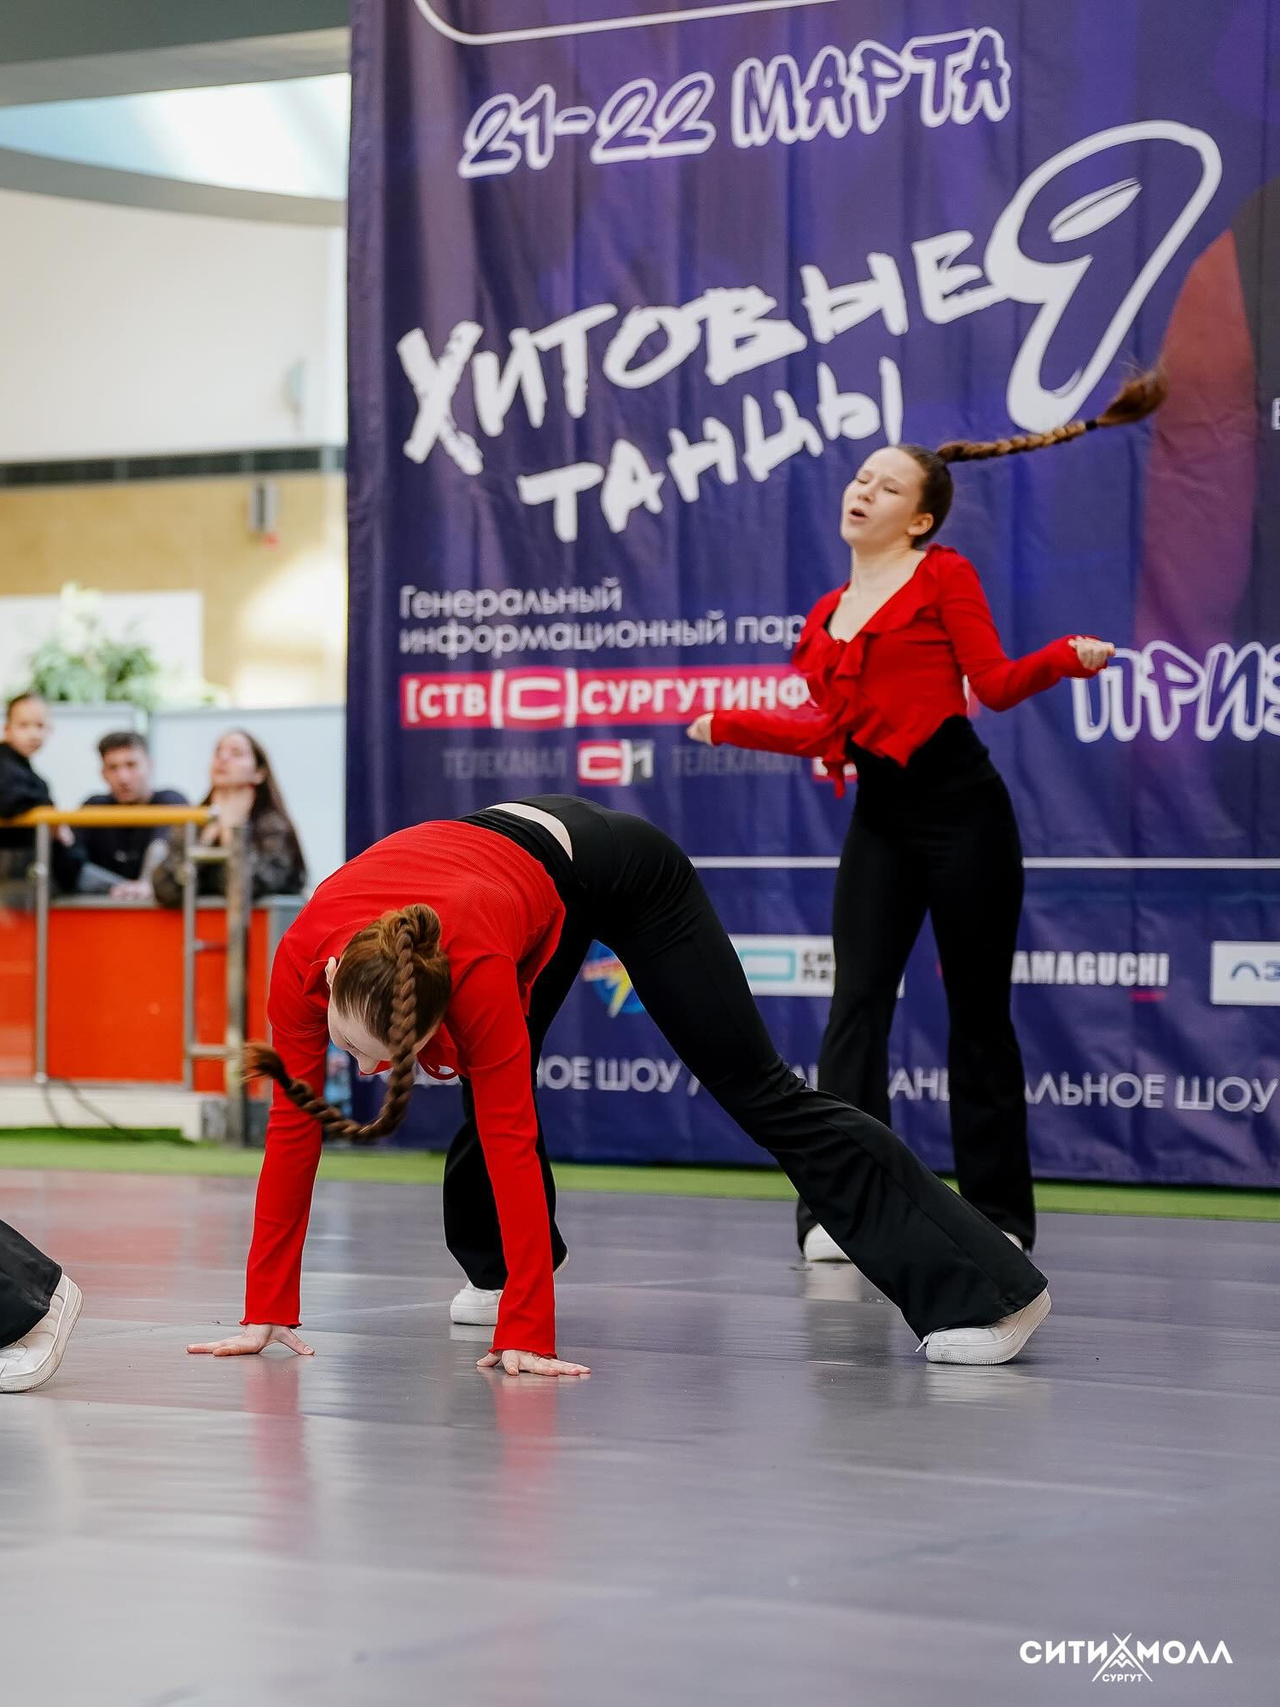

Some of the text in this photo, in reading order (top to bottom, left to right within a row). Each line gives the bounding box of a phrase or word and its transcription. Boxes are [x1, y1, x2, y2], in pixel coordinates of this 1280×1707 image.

[459, 27, 1011, 179] 21-22 МАРТА
[397, 229, 1005, 476] ХИТОВЫЕ
[517, 356, 902, 543] ТАНЦЫ
[399, 577, 622, 624] Генеральный
[399, 609, 807, 660] информационный пар
[581, 673, 811, 716] СУРГУТИНФ
[1011, 951, 1169, 986] AMAGUCHI
[595, 1057, 682, 1093] ШОУ
[1176, 1075, 1279, 1112] ШОУ
